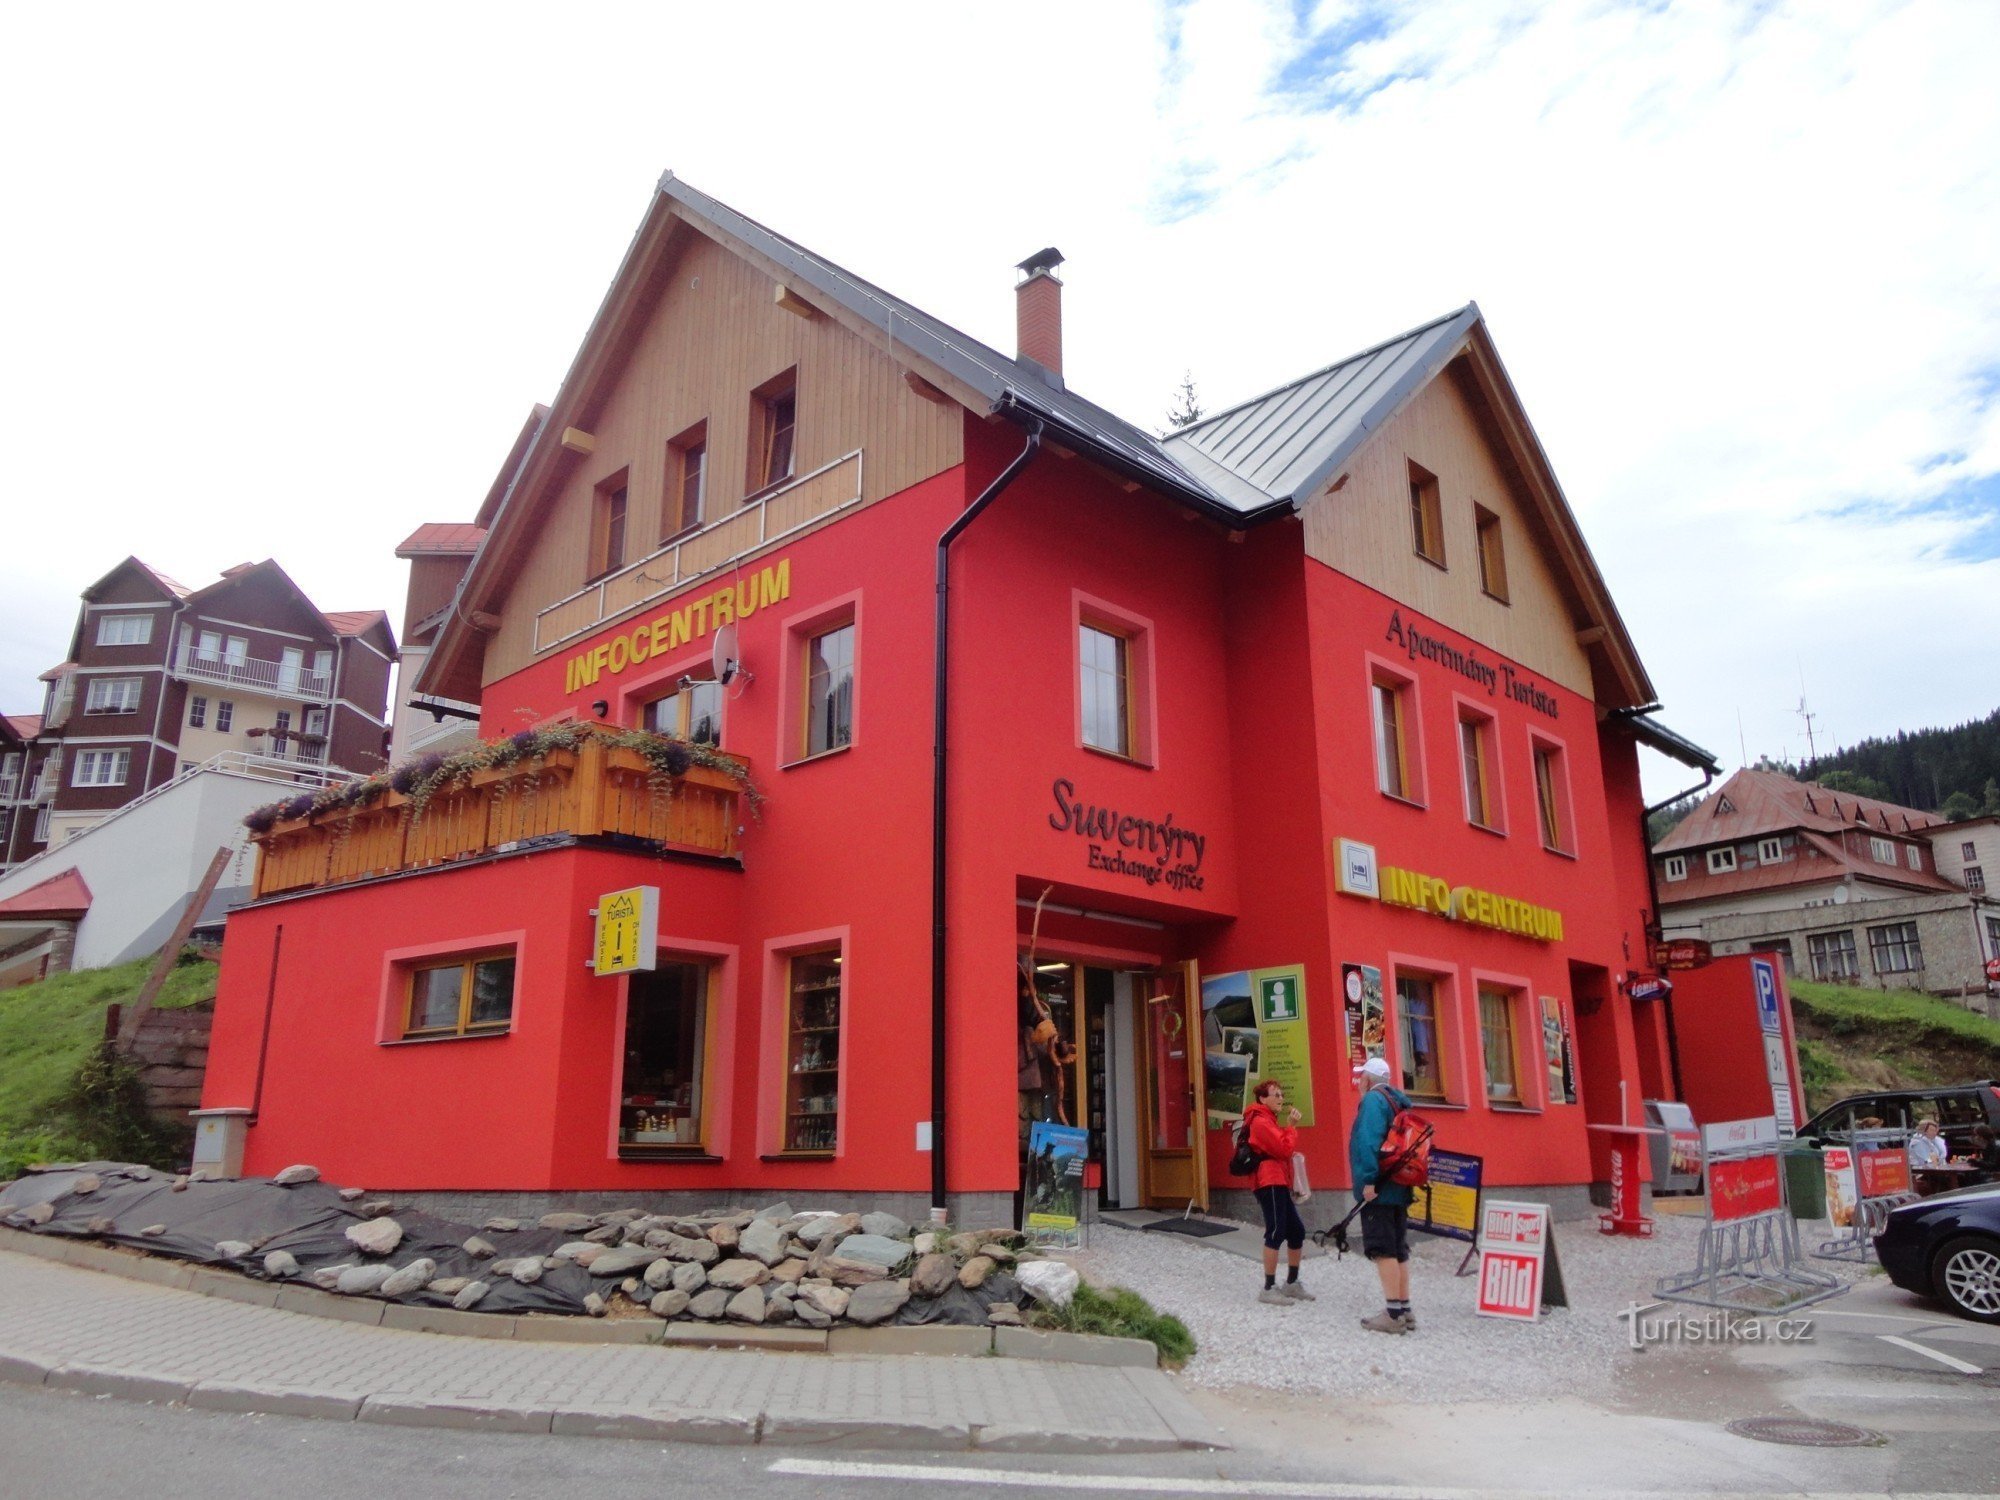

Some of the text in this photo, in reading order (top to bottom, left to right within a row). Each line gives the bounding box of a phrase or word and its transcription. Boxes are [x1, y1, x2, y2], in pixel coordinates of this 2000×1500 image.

[565, 558, 791, 695] INFOCENTRUM
[1385, 608, 1559, 719] Apartmány Turista
[1048, 777, 1206, 872] Suvenýry
[1087, 843, 1205, 892] Exchange office
[606, 907, 635, 922] TURISTA
[1383, 866, 1564, 942] INFO CENTRUM
[1758, 968, 1772, 1010] P
[1611, 1149, 1624, 1220] Coca-Cola
[1487, 1211, 1513, 1234] Bild
[1484, 1257, 1535, 1310] Bild
